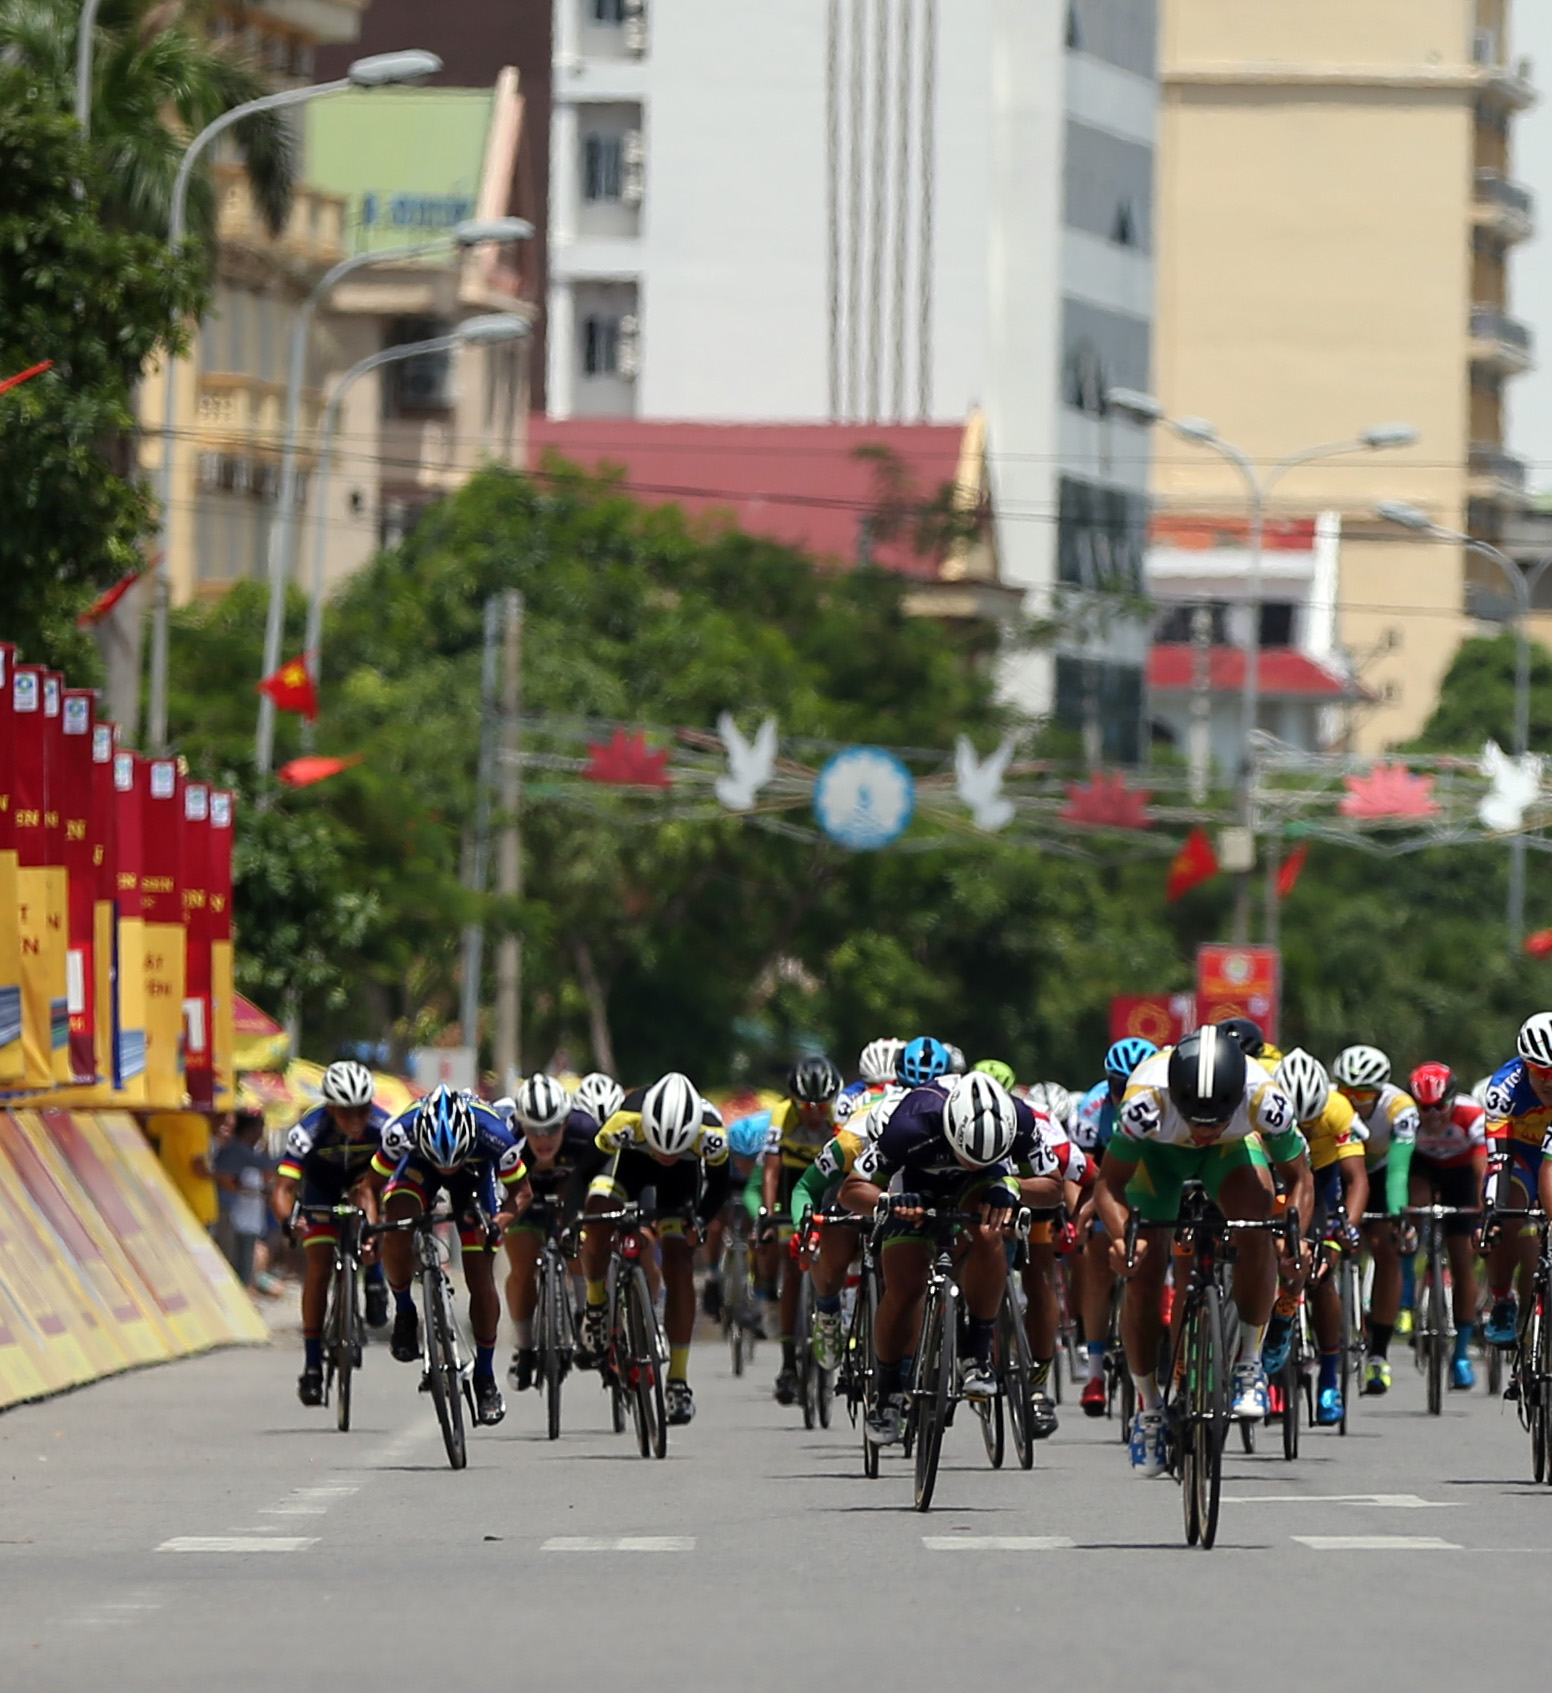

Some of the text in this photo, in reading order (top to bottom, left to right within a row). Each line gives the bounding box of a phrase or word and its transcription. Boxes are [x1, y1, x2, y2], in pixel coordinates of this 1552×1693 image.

[1127, 1102, 1158, 1133] 54
[1266, 1094, 1288, 1127] 54
[703, 1135, 723, 1156] 26
[1029, 1147, 1056, 1172] 76
